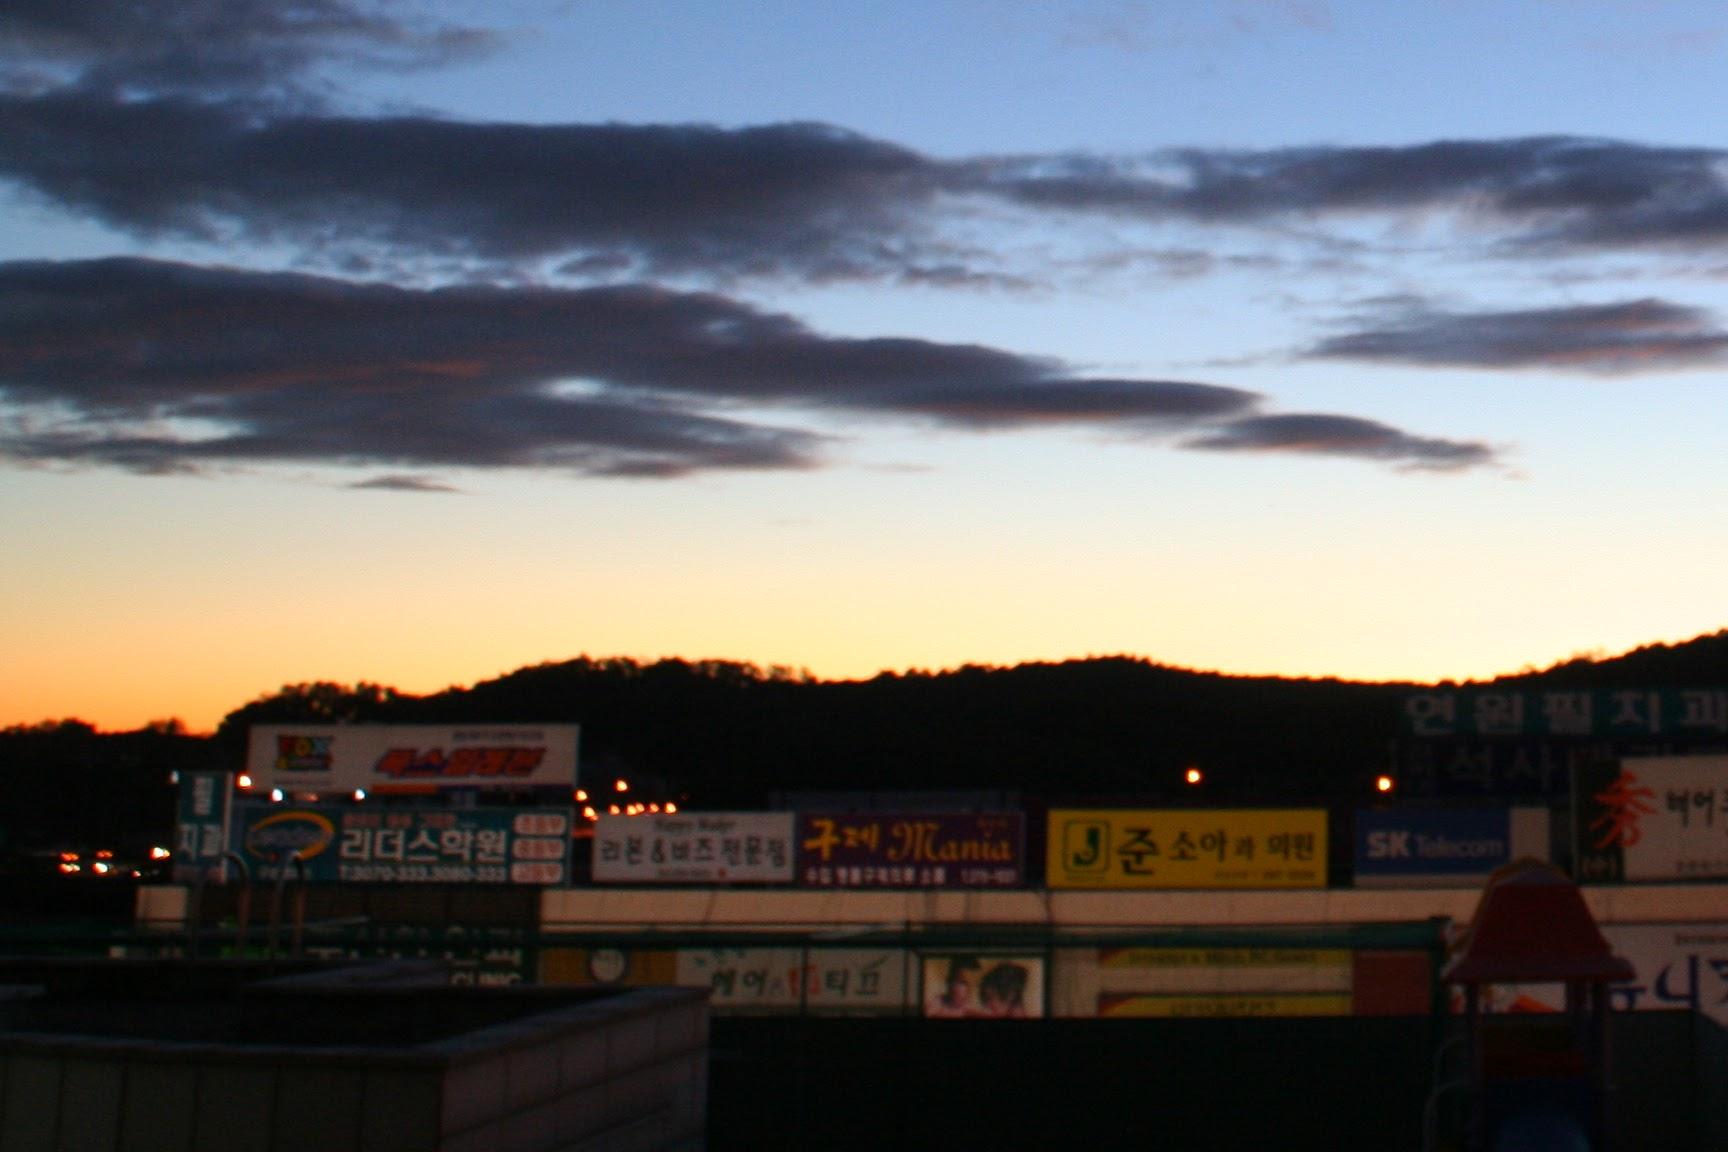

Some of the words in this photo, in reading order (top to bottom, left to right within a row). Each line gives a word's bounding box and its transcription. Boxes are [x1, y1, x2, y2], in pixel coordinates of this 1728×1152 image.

[339, 829, 507, 867] 리더스학원
[886, 820, 1013, 862] Mania
[1117, 827, 1160, 877] 준
[1366, 830, 1411, 859] SK
[1413, 833, 1504, 859] Telecom
